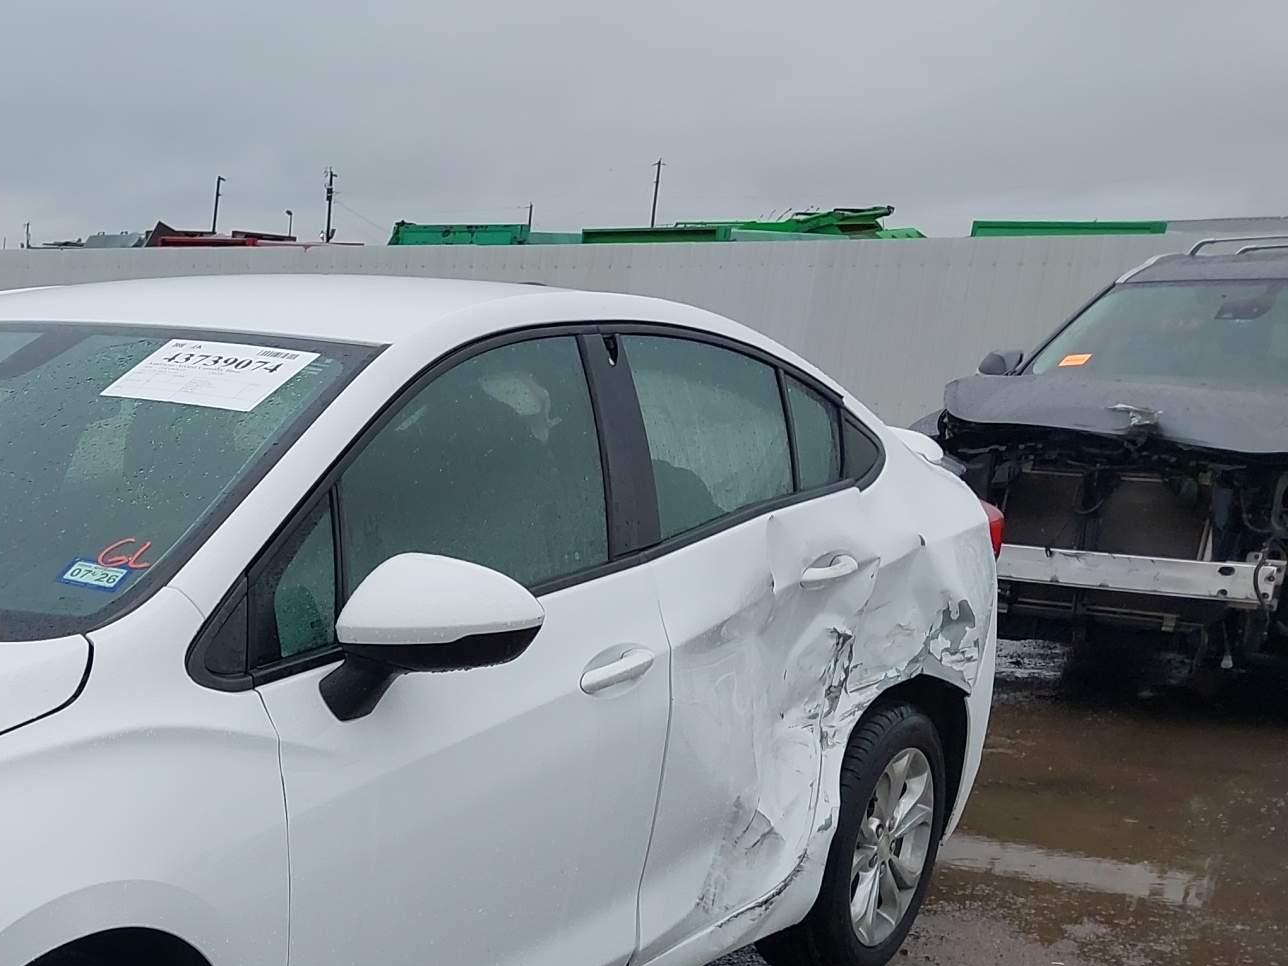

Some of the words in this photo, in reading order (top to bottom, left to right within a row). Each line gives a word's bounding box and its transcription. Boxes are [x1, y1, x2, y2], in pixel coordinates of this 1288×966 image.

[163, 352, 284, 373] 43739074
[70, 567, 91, 580] 07
[94, 572, 119, 585] 26
